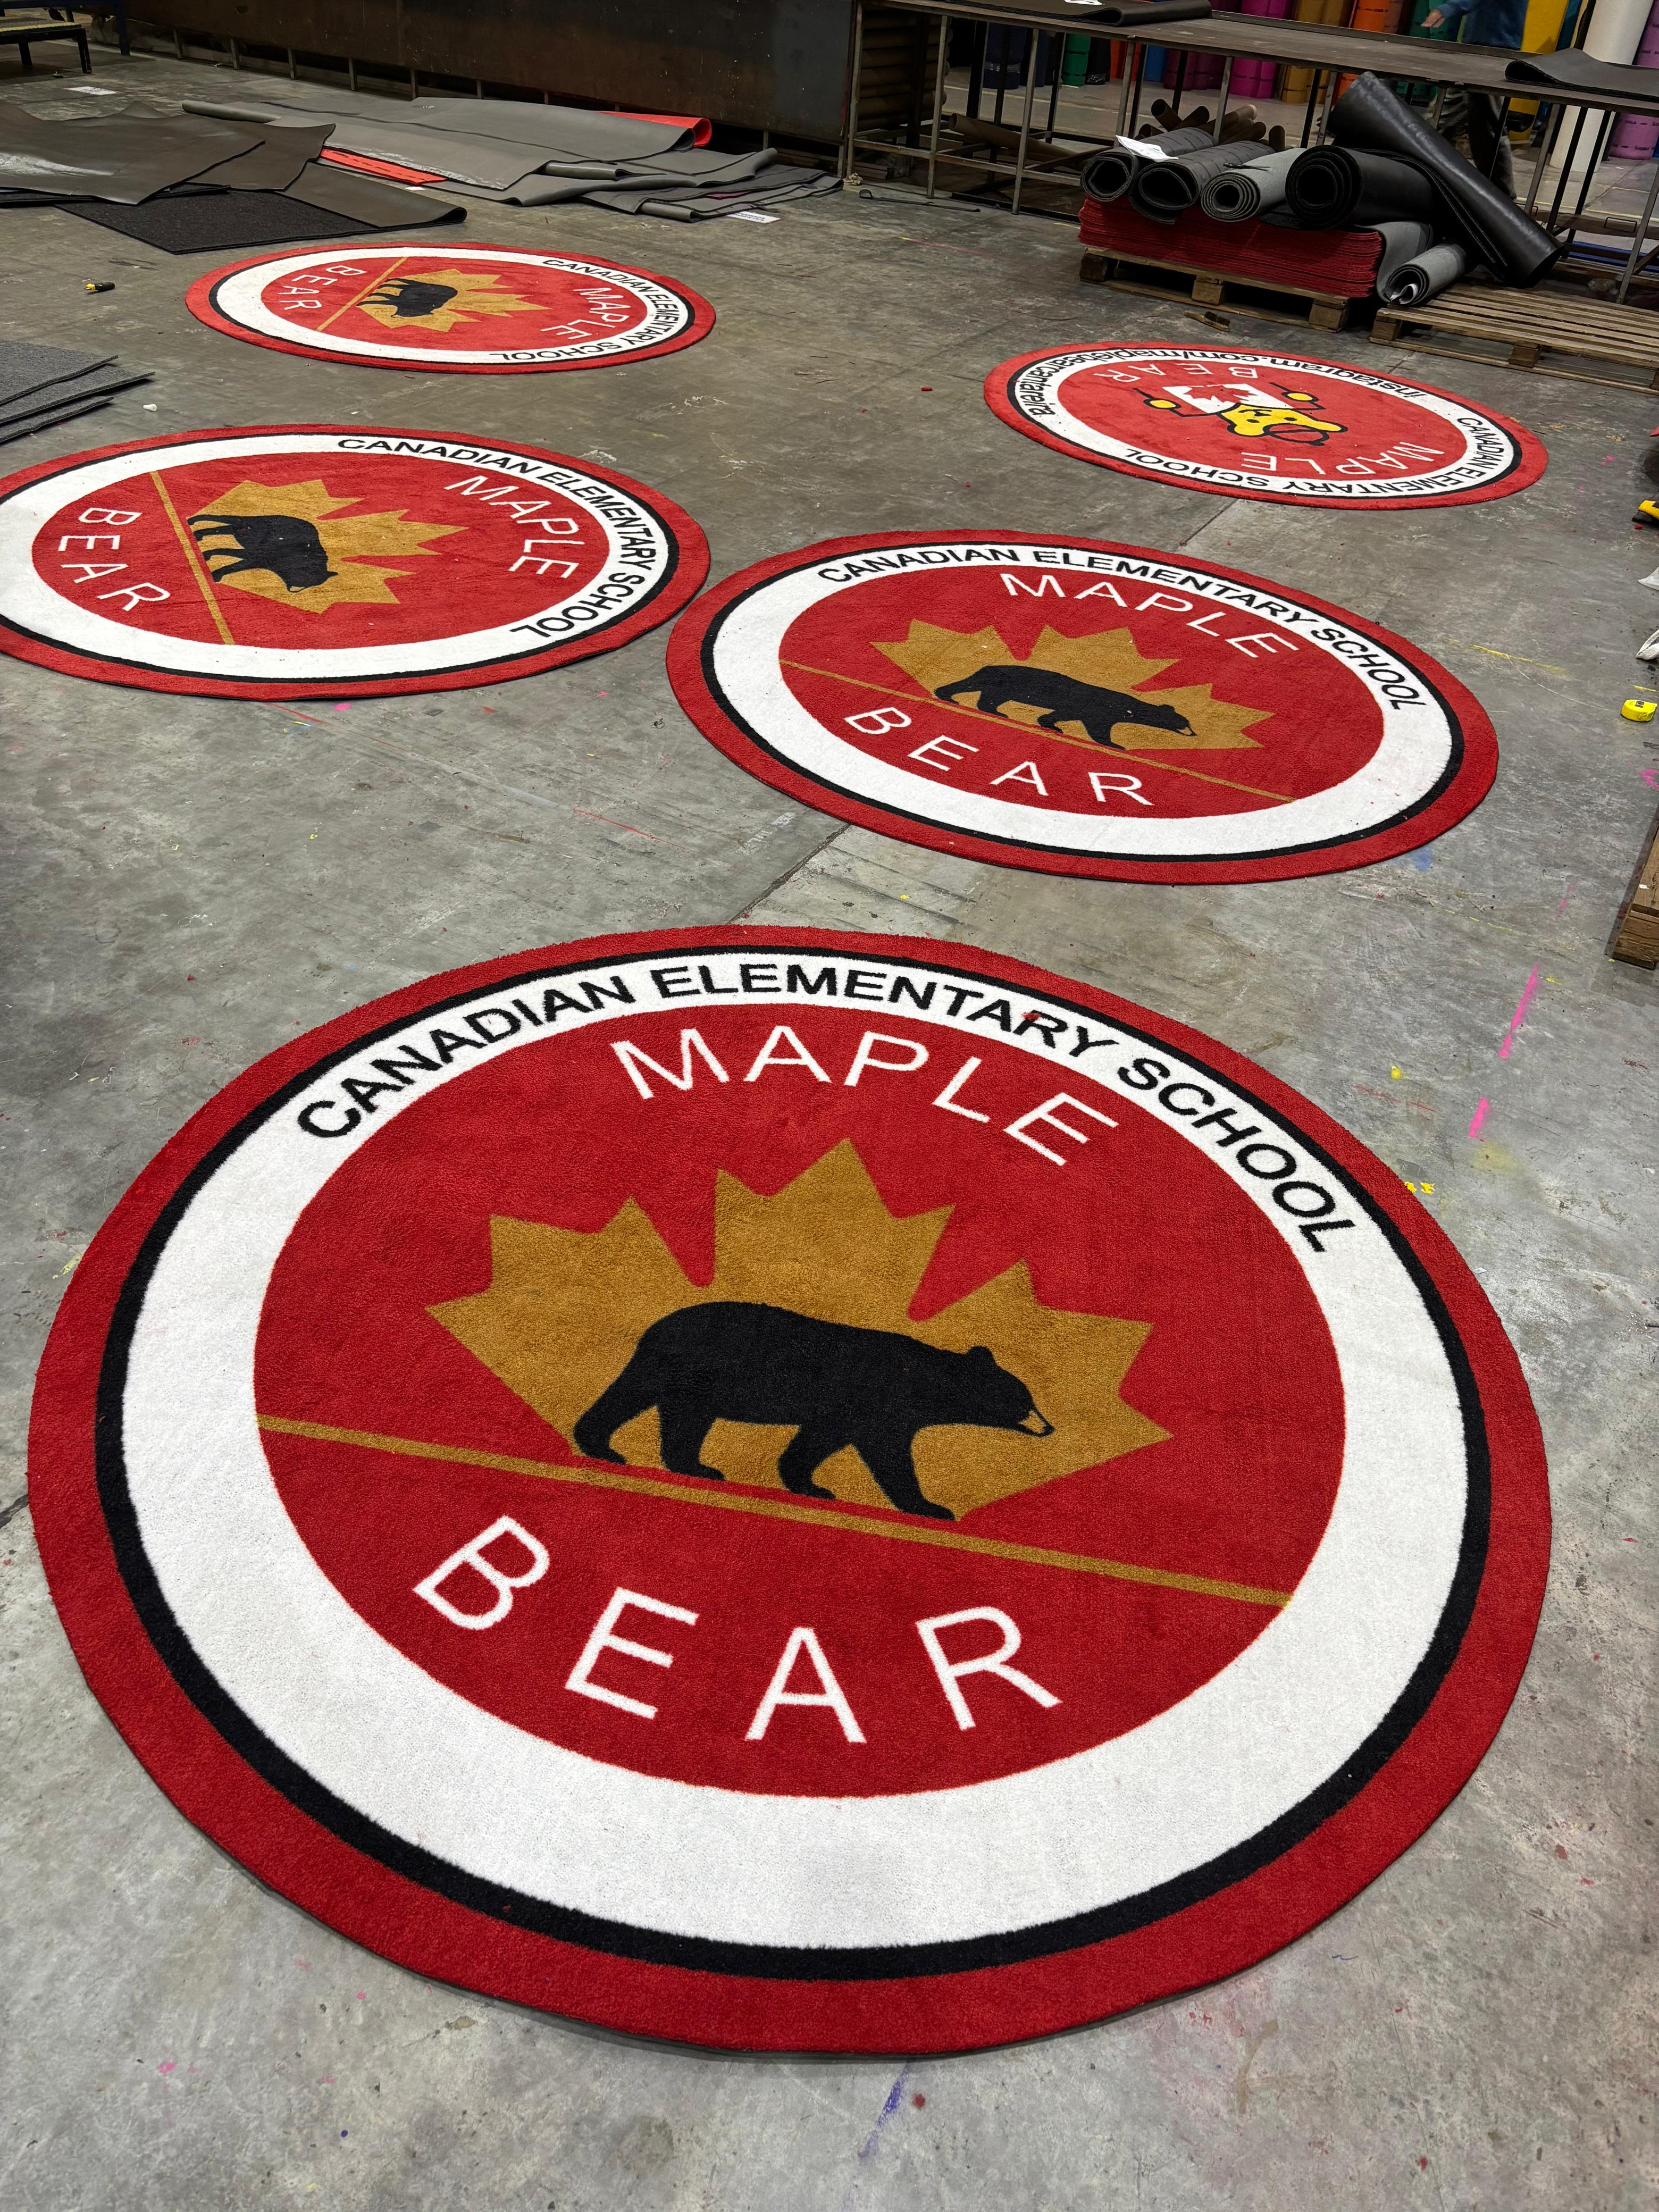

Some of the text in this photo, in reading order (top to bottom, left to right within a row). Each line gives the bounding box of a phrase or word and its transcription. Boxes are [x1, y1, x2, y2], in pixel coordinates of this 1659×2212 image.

[278, 265, 368, 310] BEAR
[489, 259, 678, 361] CANADIAN ELEMENTARY SCHOOL
[540, 287, 631, 339] MAPLE
[1093, 363, 1258, 382] BEAR
[1124, 417, 1505, 494] CANADIAN ELEMENTARY SCHOOL
[1241, 442, 1445, 475] MAPLE
[57, 506, 171, 611] BEAR
[338, 438, 657, 638] CANADIAN ELEMENTARY SCHOOL
[444, 475, 585, 579] MAPLE
[817, 548, 1427, 713] CANADIAN ELEMENTARY SCHOOL
[1000, 572, 1299, 659] MAPLE
[844, 707, 1154, 806] BEAR
[297, 963, 1355, 1253] CANADIAN ELEMENTARY SCHOOL
[610, 1025, 1119, 1167] MAPLE
[413, 1514, 1063, 1744] BEAR
